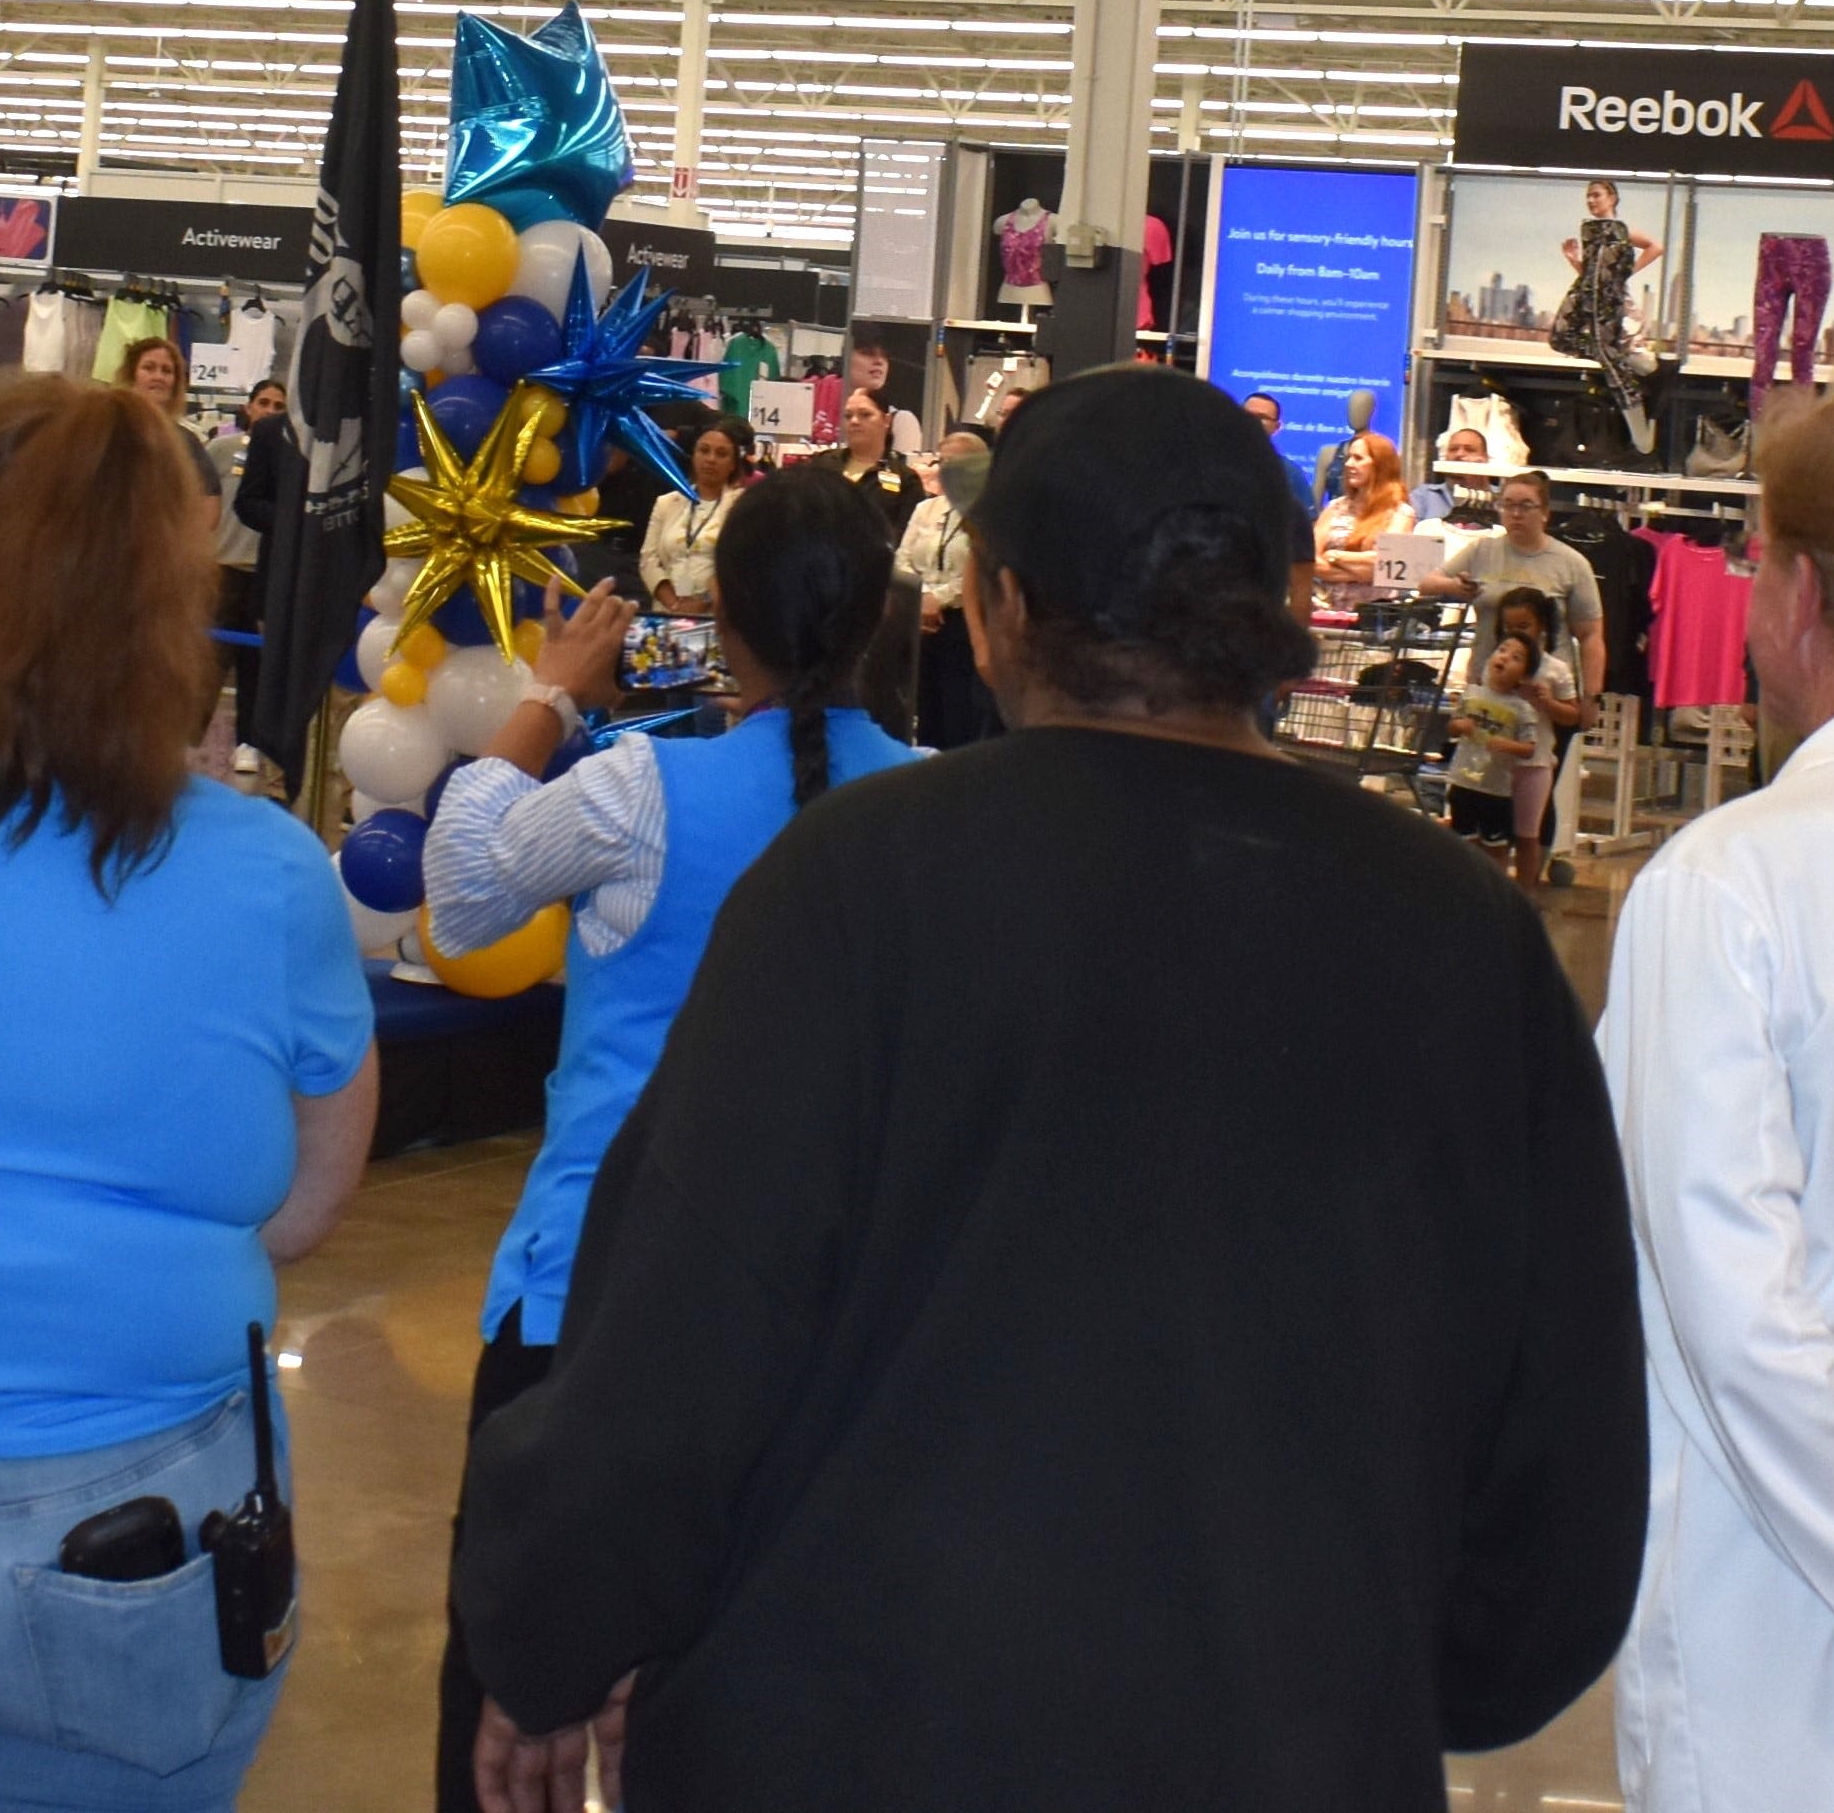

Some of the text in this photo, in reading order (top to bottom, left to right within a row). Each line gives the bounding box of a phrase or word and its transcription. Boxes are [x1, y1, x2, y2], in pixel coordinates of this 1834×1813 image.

[1558, 86, 1765, 138] Reebok
[181, 226, 282, 251] Activewear
[1228, 227, 1252, 240] Join
[1253, 231, 1267, 241] us
[1268, 229, 1286, 241] for
[1380, 235, 1414, 248] hours
[626, 242, 691, 270] Activewear
[1256, 262, 1286, 278] Daily
[1287, 264, 1316, 277] from
[753, 406, 781, 427] $14
[1378, 559, 1407, 581] $12
